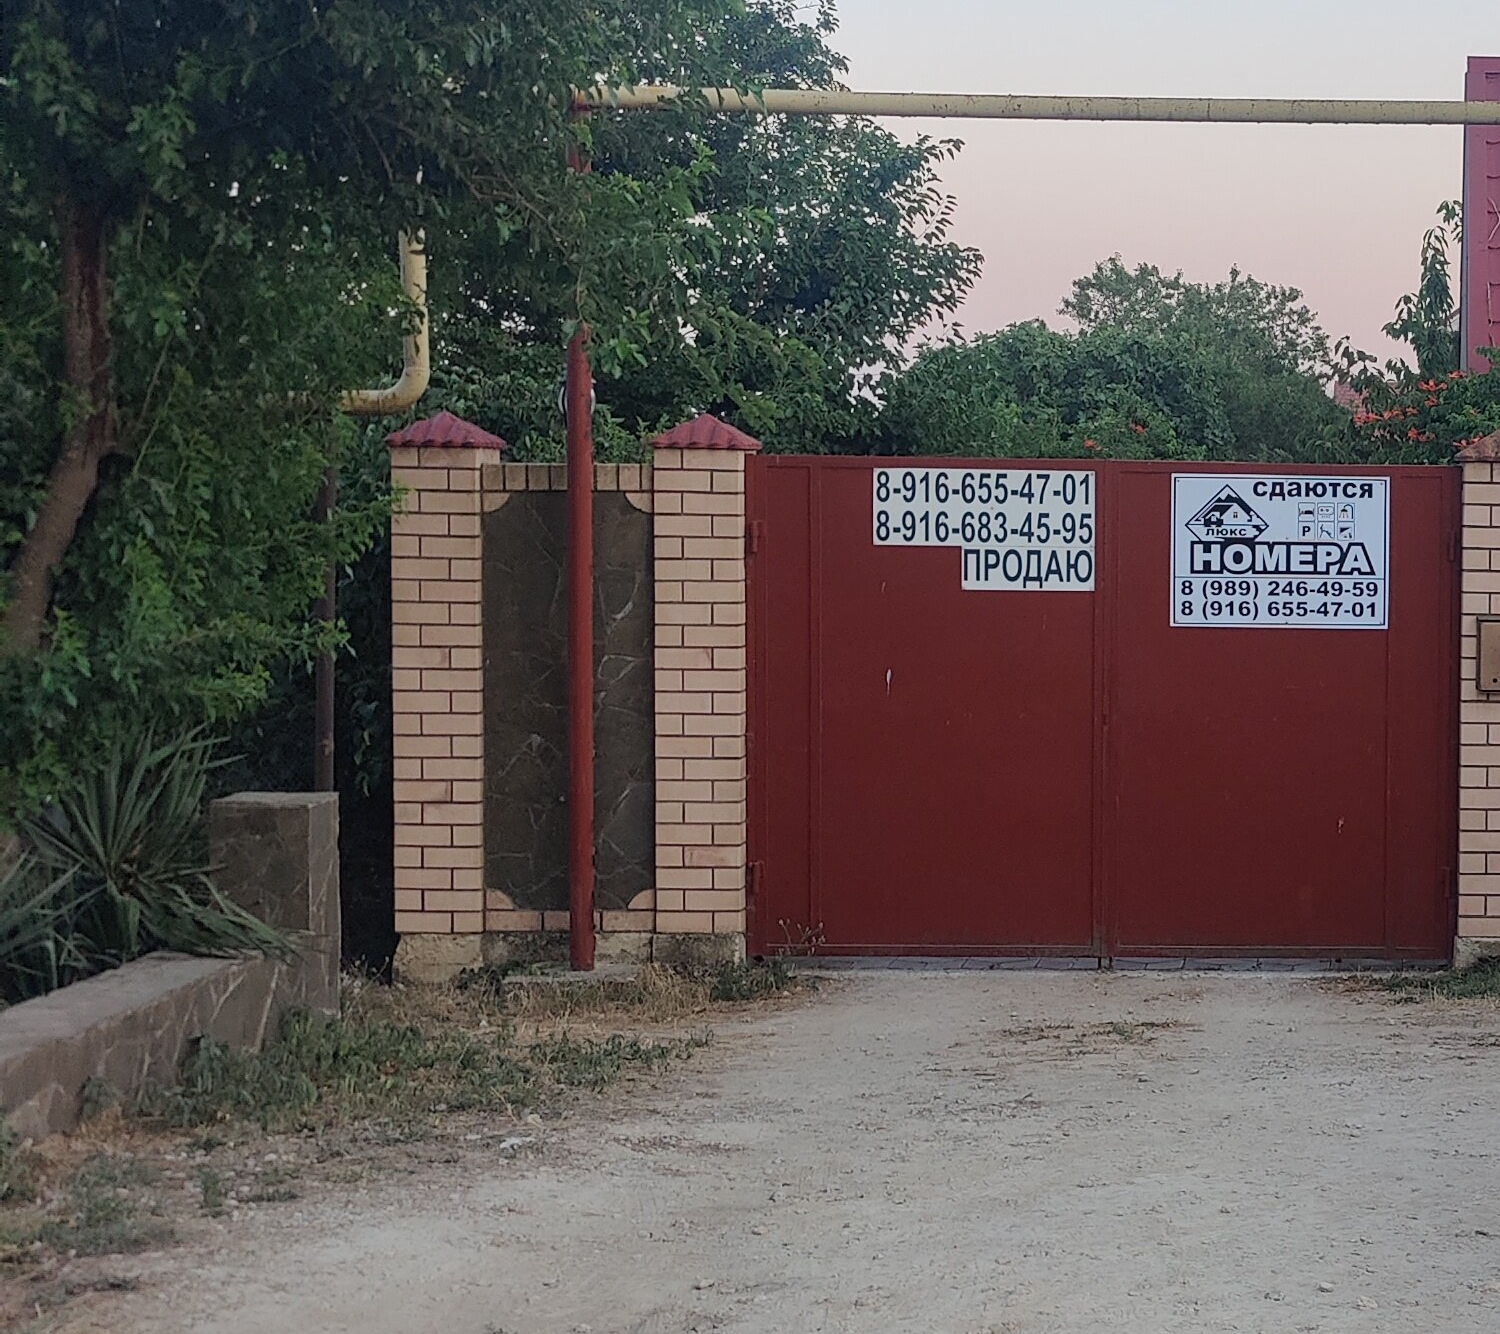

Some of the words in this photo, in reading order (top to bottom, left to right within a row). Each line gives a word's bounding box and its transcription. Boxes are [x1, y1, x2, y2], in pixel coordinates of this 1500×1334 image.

[876, 470, 1091, 505] 8-916-655-47-01
[1253, 481, 1374, 501] сдаются
[876, 510, 1093, 544] 8-916-683-45-95
[963, 549, 1093, 589] ПРОДАЮ
[1191, 541, 1376, 576] НОМЕРА
[1181, 580, 1194, 596] 8
[1202, 580, 1259, 599] (989)
[1268, 581, 1378, 597] 246-49-59
[1181, 601, 1194, 616] 8
[1202, 601, 1259, 620] (916)
[1268, 602, 1377, 617] 655-47-01
